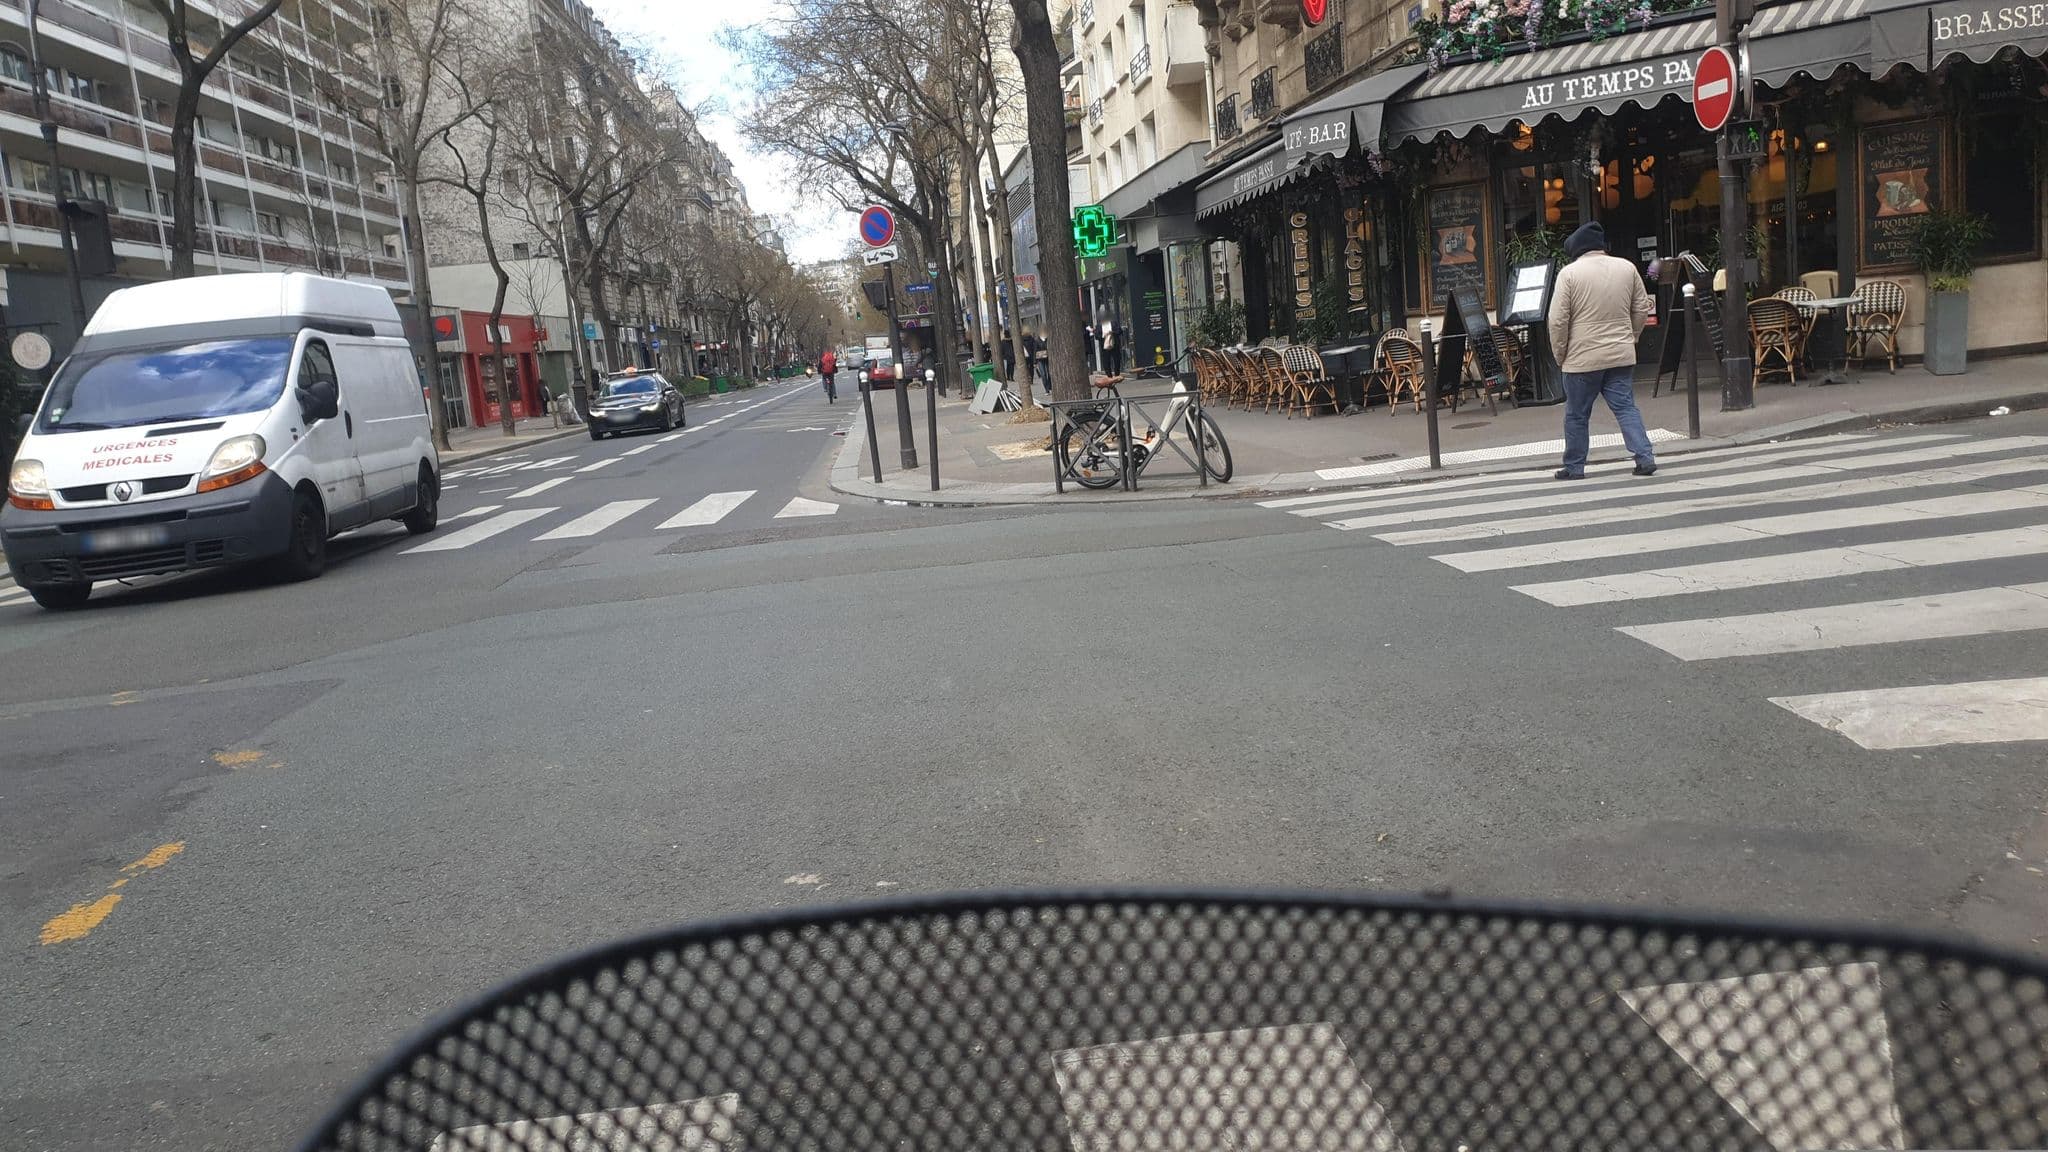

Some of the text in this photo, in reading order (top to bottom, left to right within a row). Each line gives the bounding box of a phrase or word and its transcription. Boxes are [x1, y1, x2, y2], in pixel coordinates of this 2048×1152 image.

[1934, 4, 2048, 40] BRASSE
[1521, 82, 1555, 109] AU
[1562, 66, 1655, 102] TEMPS
[92, 438, 178, 454] URGENCES
[81, 453, 174, 471] MEDICALES
